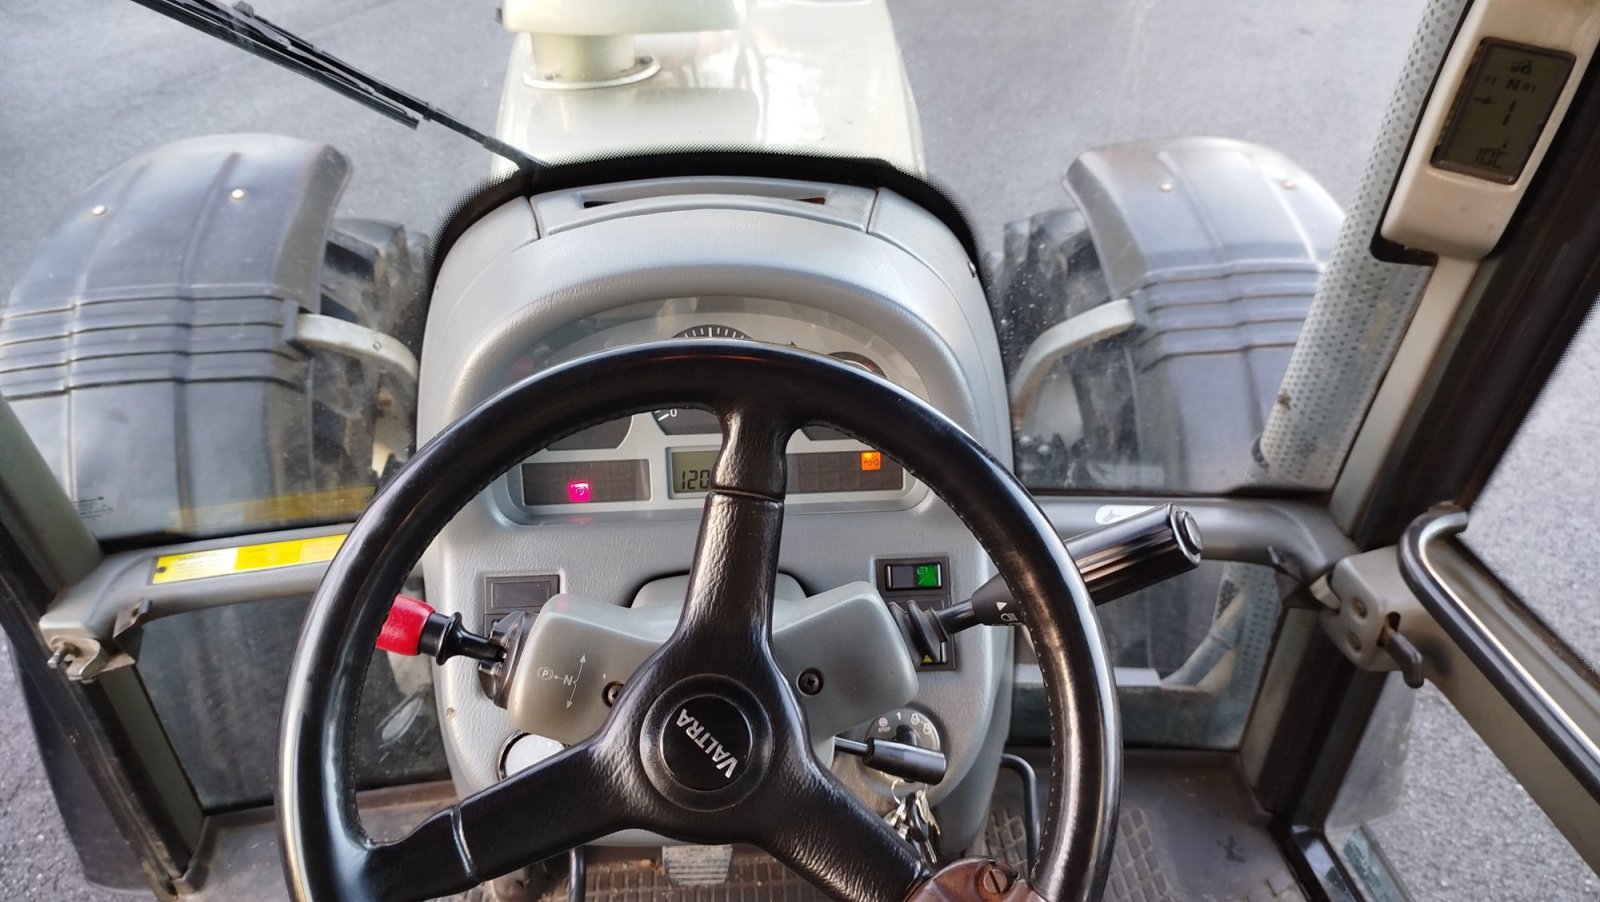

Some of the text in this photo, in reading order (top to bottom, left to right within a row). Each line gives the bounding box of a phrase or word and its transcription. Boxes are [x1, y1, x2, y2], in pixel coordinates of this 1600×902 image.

[670, 408, 678, 418] 0
[681, 469, 711, 490] 120
[562, 674, 574, 686] N
[676, 708, 738, 778] VALTRA
